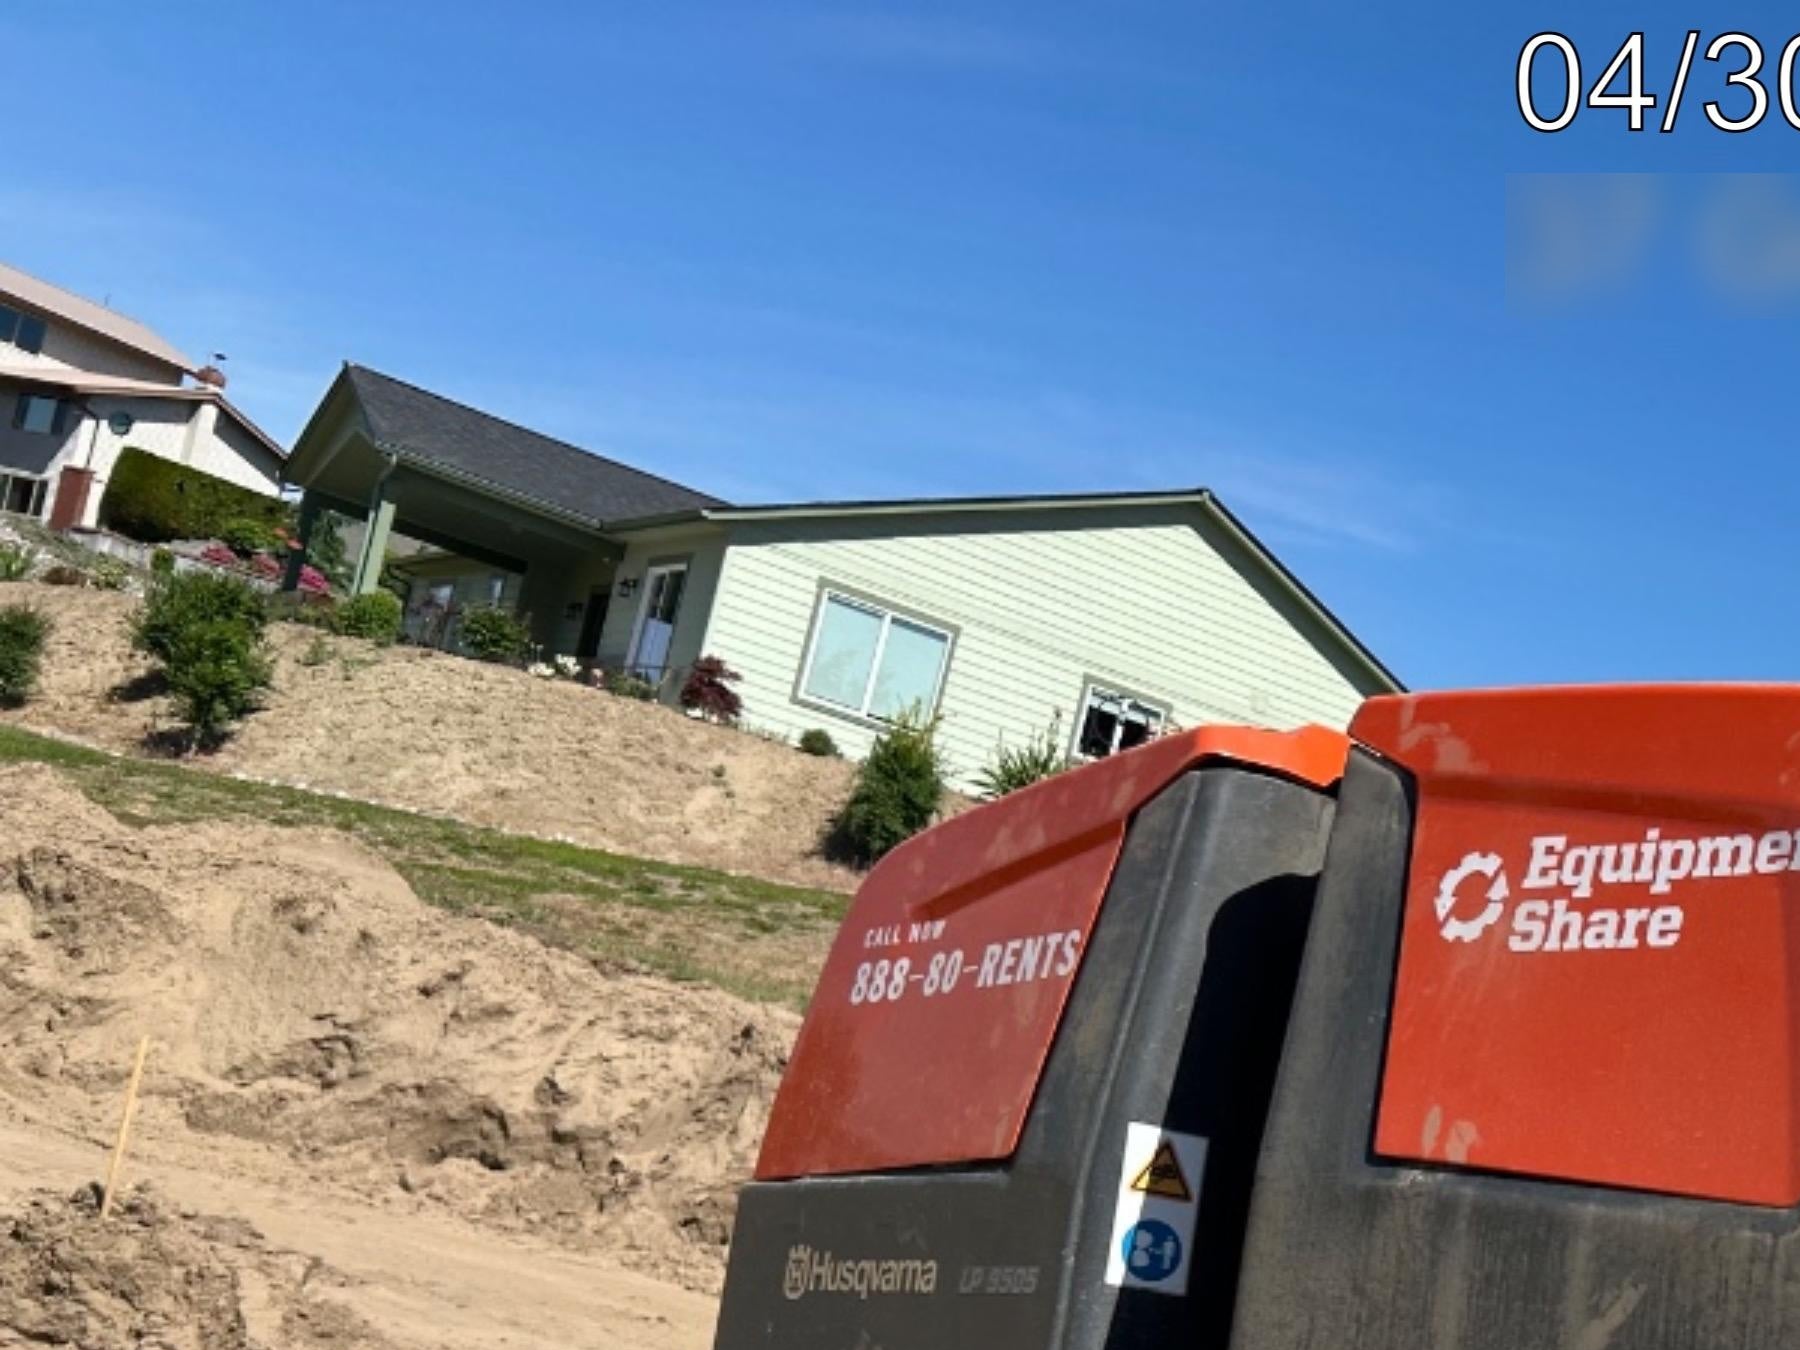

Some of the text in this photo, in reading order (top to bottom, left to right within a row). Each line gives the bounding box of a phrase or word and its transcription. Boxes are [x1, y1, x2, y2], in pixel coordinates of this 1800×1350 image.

[863, 919, 947, 948] CALL NOW
[1509, 899, 1684, 953] Share
[850, 929, 1082, 1006] 888-80-RENTS
[808, 1250, 938, 1300] Husqvarna
